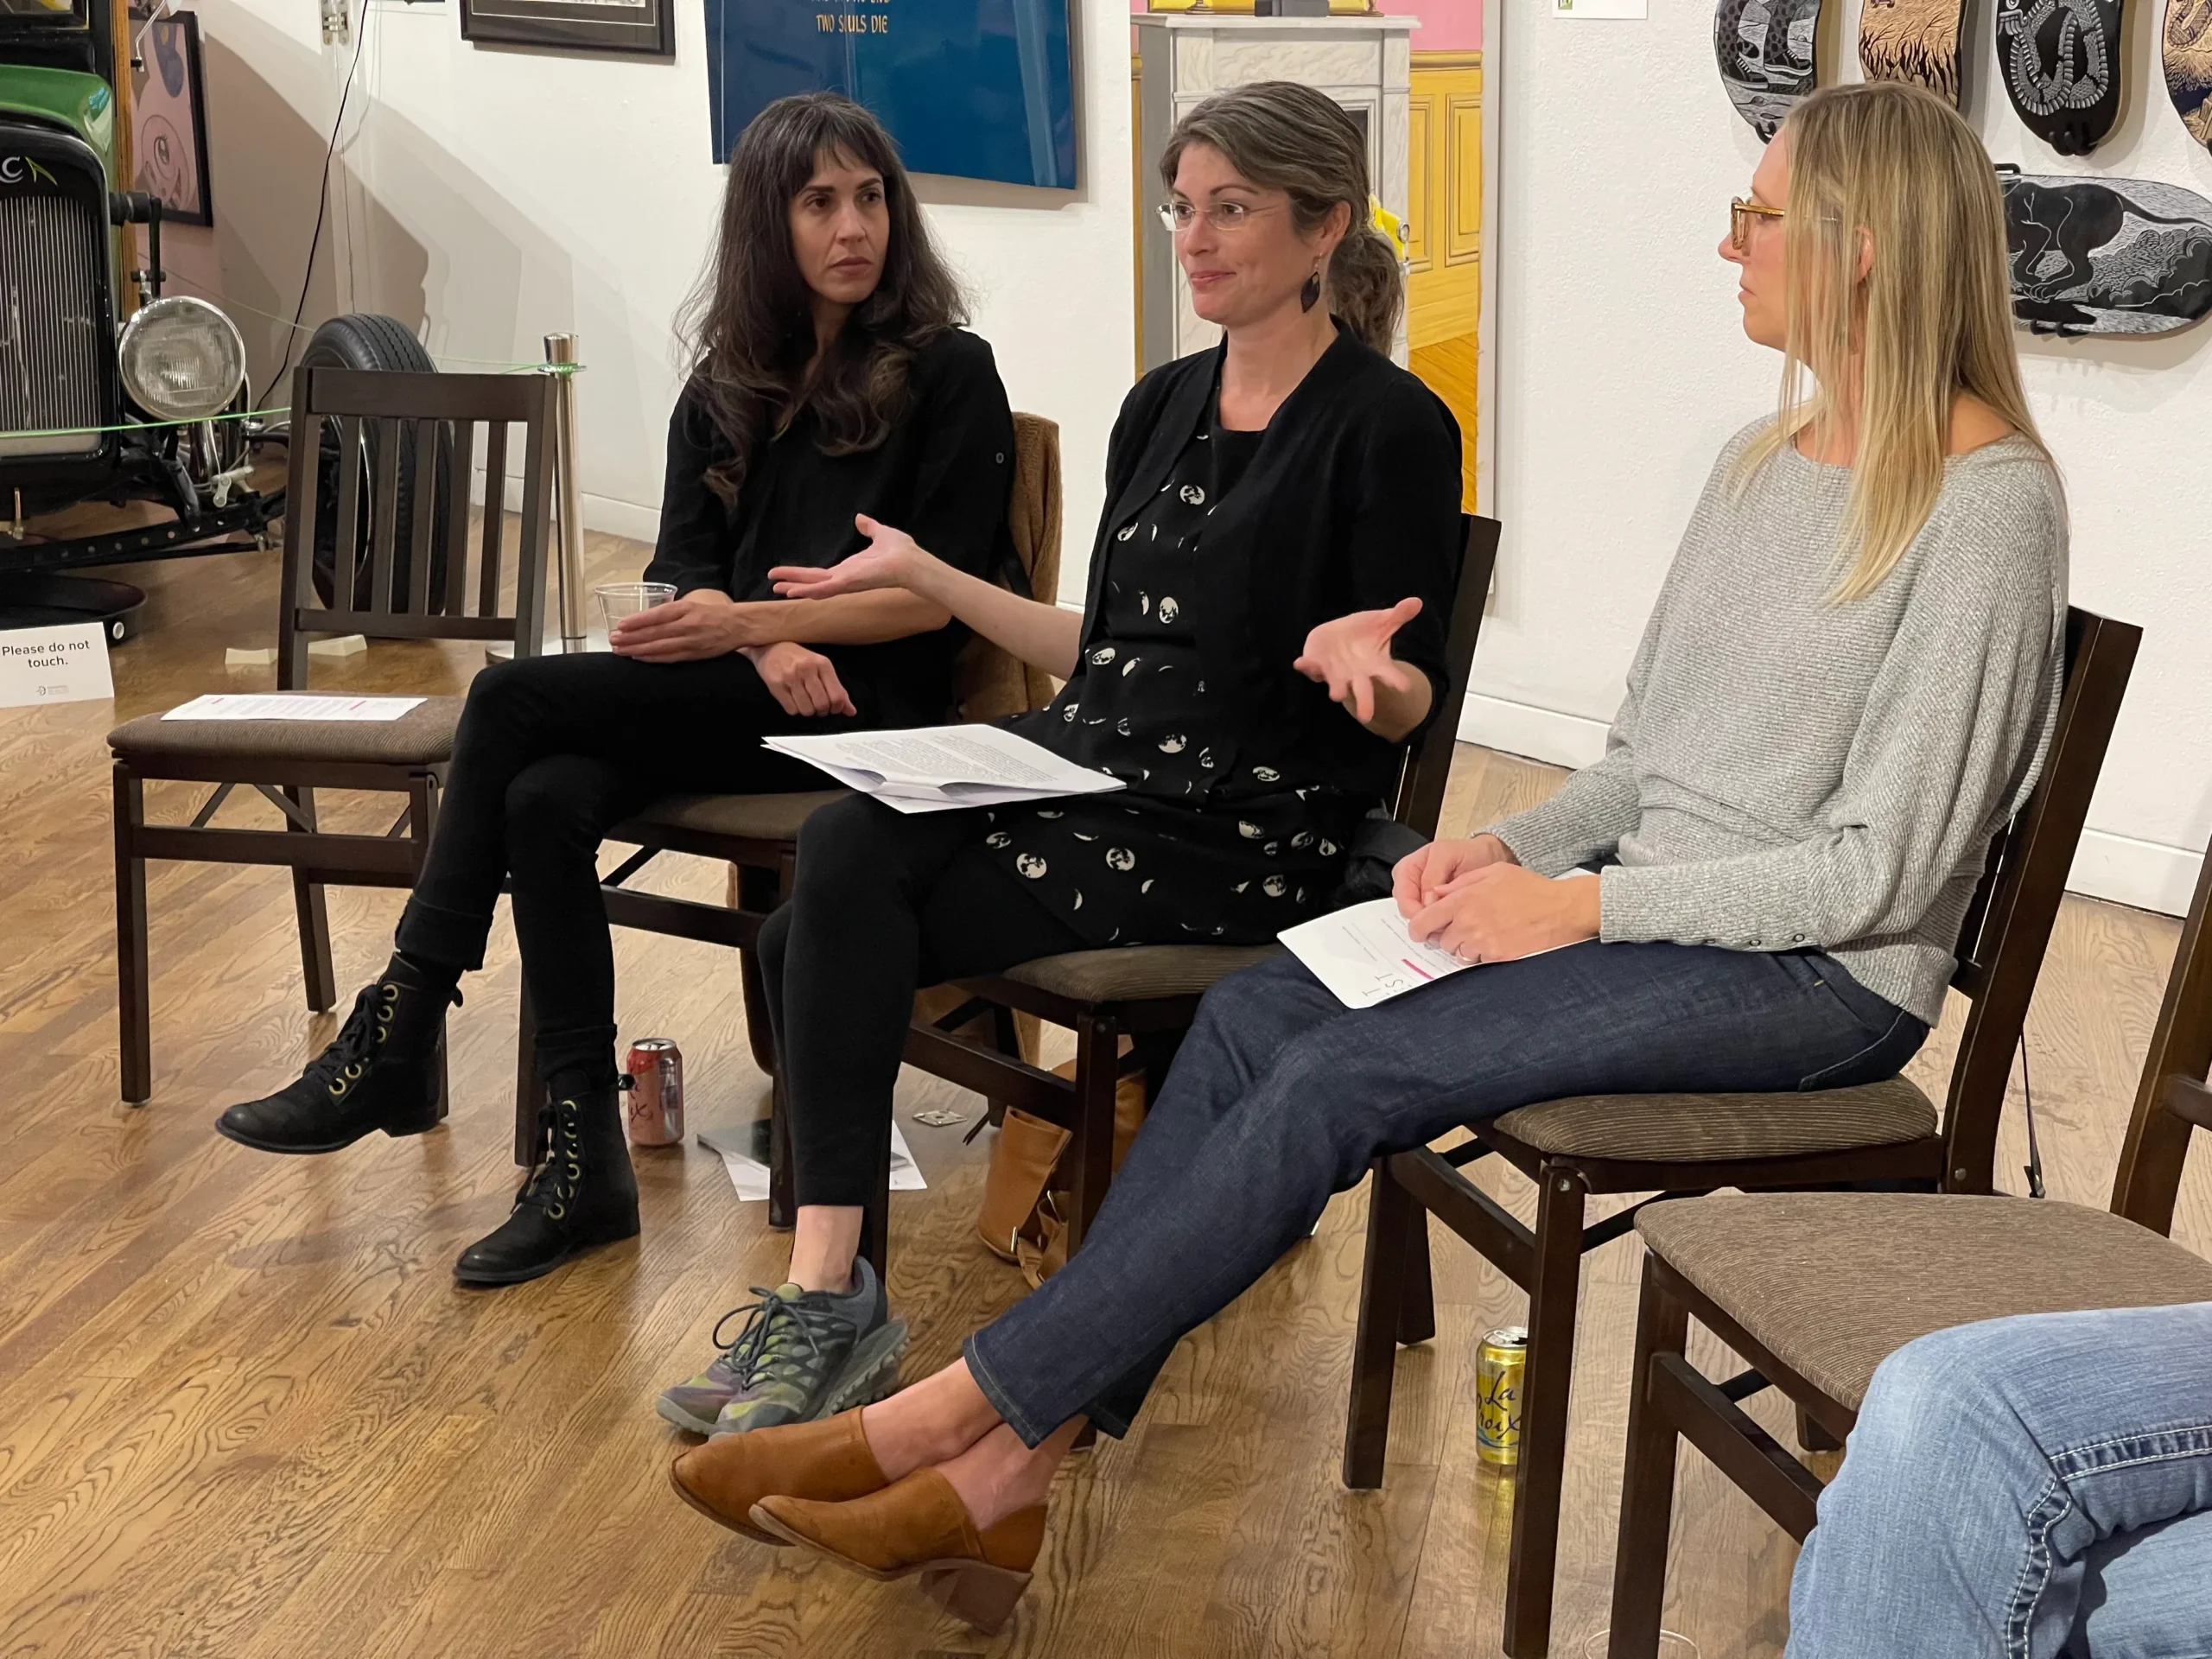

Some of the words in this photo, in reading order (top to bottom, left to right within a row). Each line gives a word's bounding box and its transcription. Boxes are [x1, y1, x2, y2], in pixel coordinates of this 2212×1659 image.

[816, 14, 835, 33] TWO
[838, 14, 868, 33] SULS
[871, 15, 888, 34] DIE
[2, 645, 45, 657] Please
[48, 642, 65, 652] do
[68, 639, 91, 651] not
[28, 656, 68, 669] touch.
[1484, 1370, 1516, 1411] La
